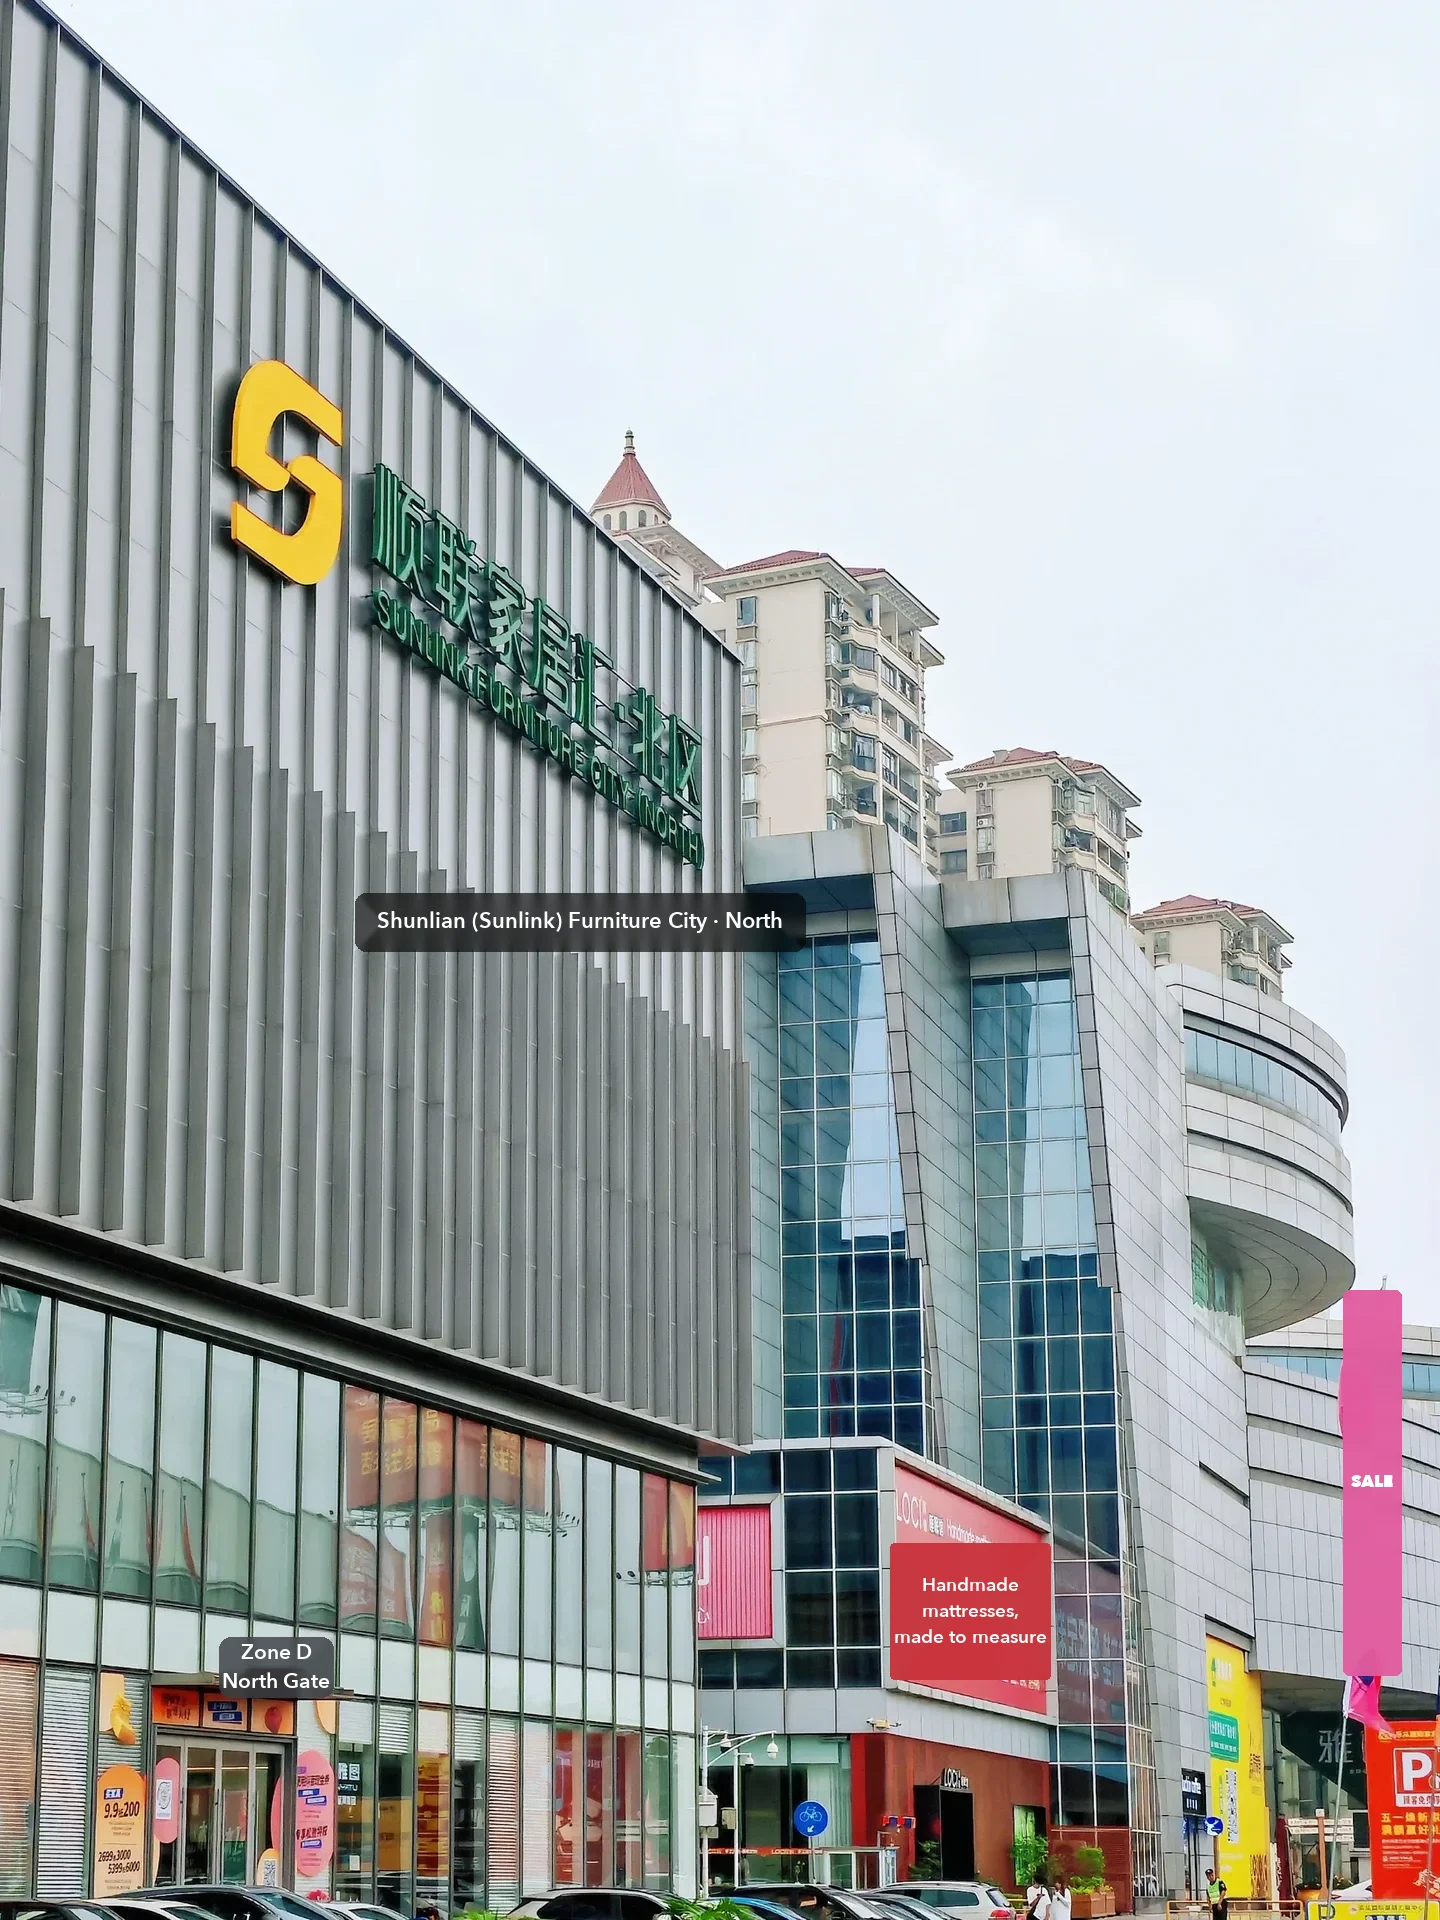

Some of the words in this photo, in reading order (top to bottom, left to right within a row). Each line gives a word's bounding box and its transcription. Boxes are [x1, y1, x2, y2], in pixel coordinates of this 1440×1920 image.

[373, 589, 473, 693] SUNLINK
[473, 664, 588, 777] FURNITURE
[589, 755, 630, 811] CITY
[1402, 1752, 1433, 1791] P
